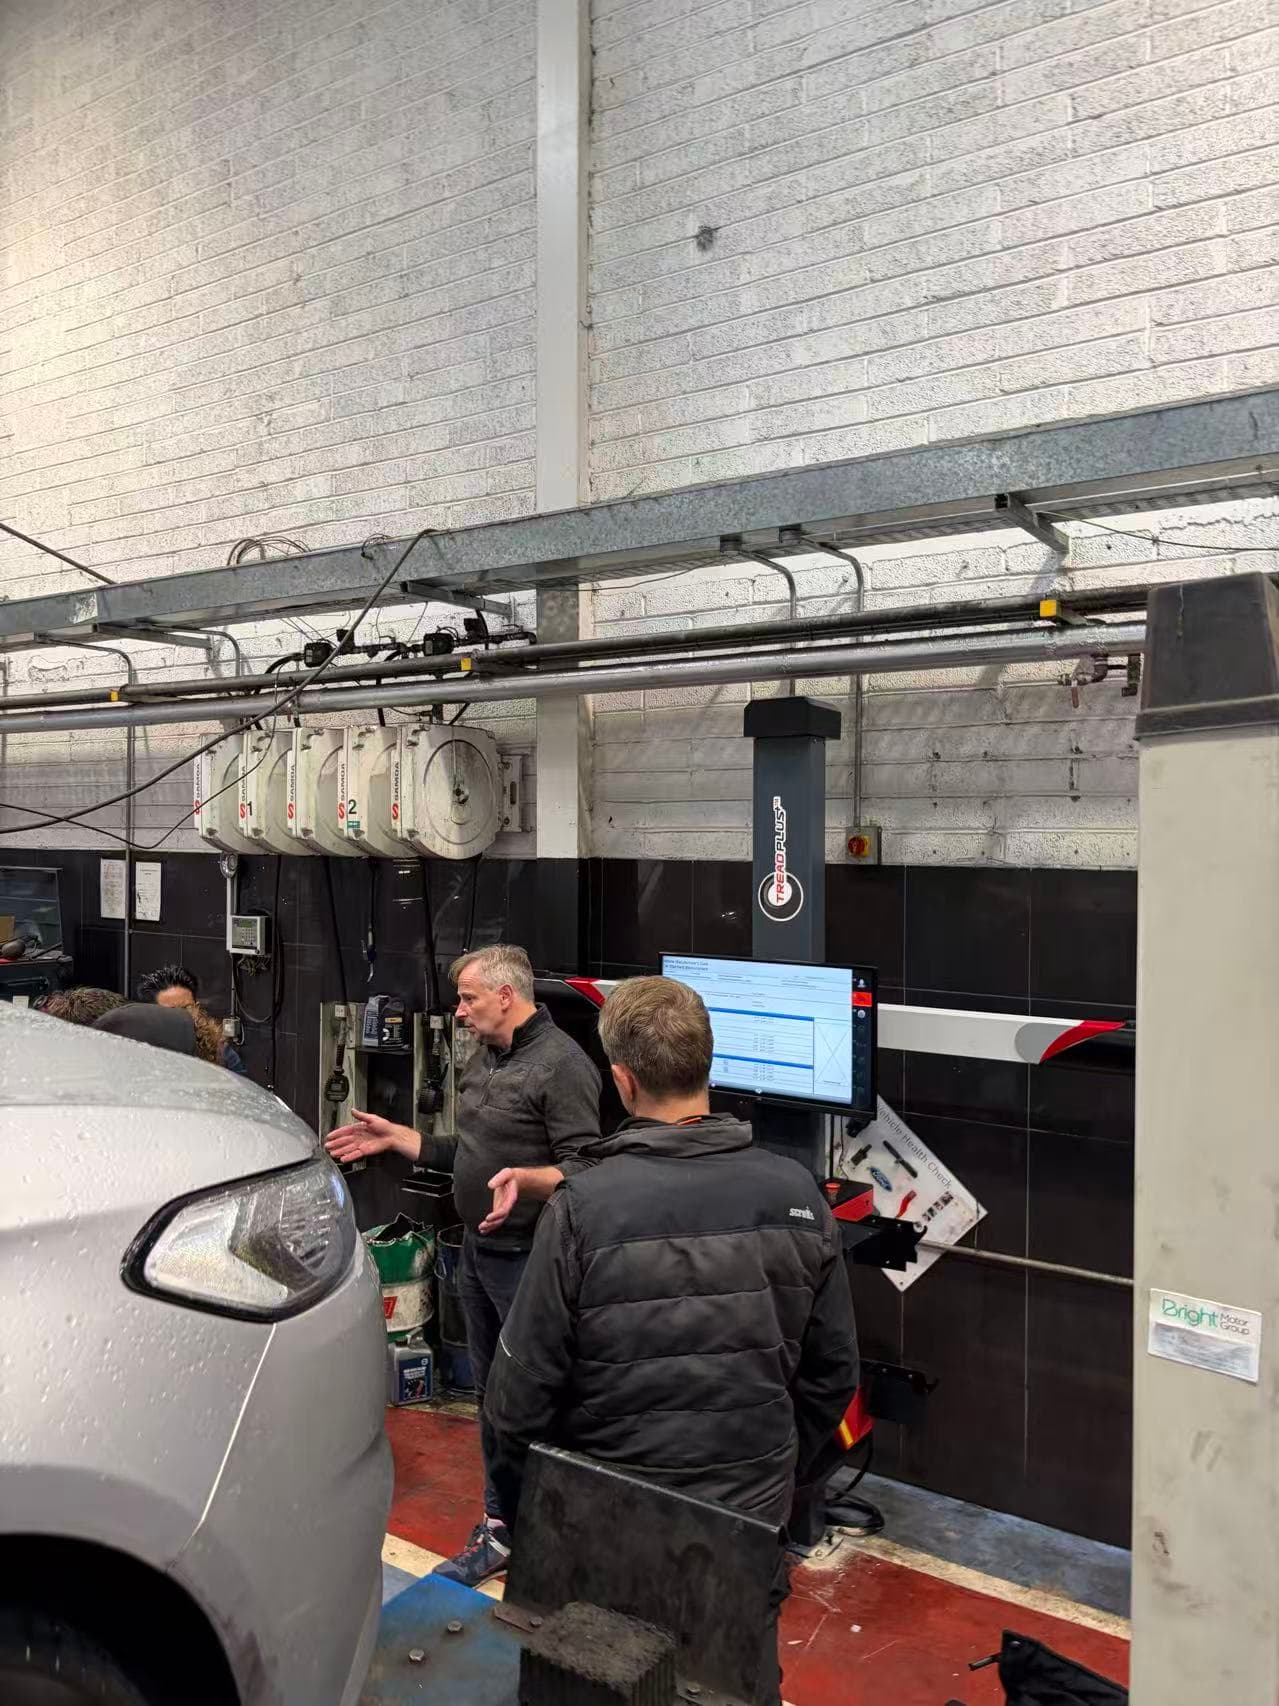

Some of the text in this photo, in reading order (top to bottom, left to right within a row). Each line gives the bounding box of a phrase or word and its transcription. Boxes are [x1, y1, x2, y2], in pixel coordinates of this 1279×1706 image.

[247, 801, 252, 817] 1
[348, 799, 357, 815] 2
[902, 1133, 928, 1163] Health
[928, 1161, 952, 1190] Check
[1162, 1298, 1218, 1326] Bright
[1220, 1313, 1248, 1326] Motor
[1220, 1321, 1249, 1335] Group
